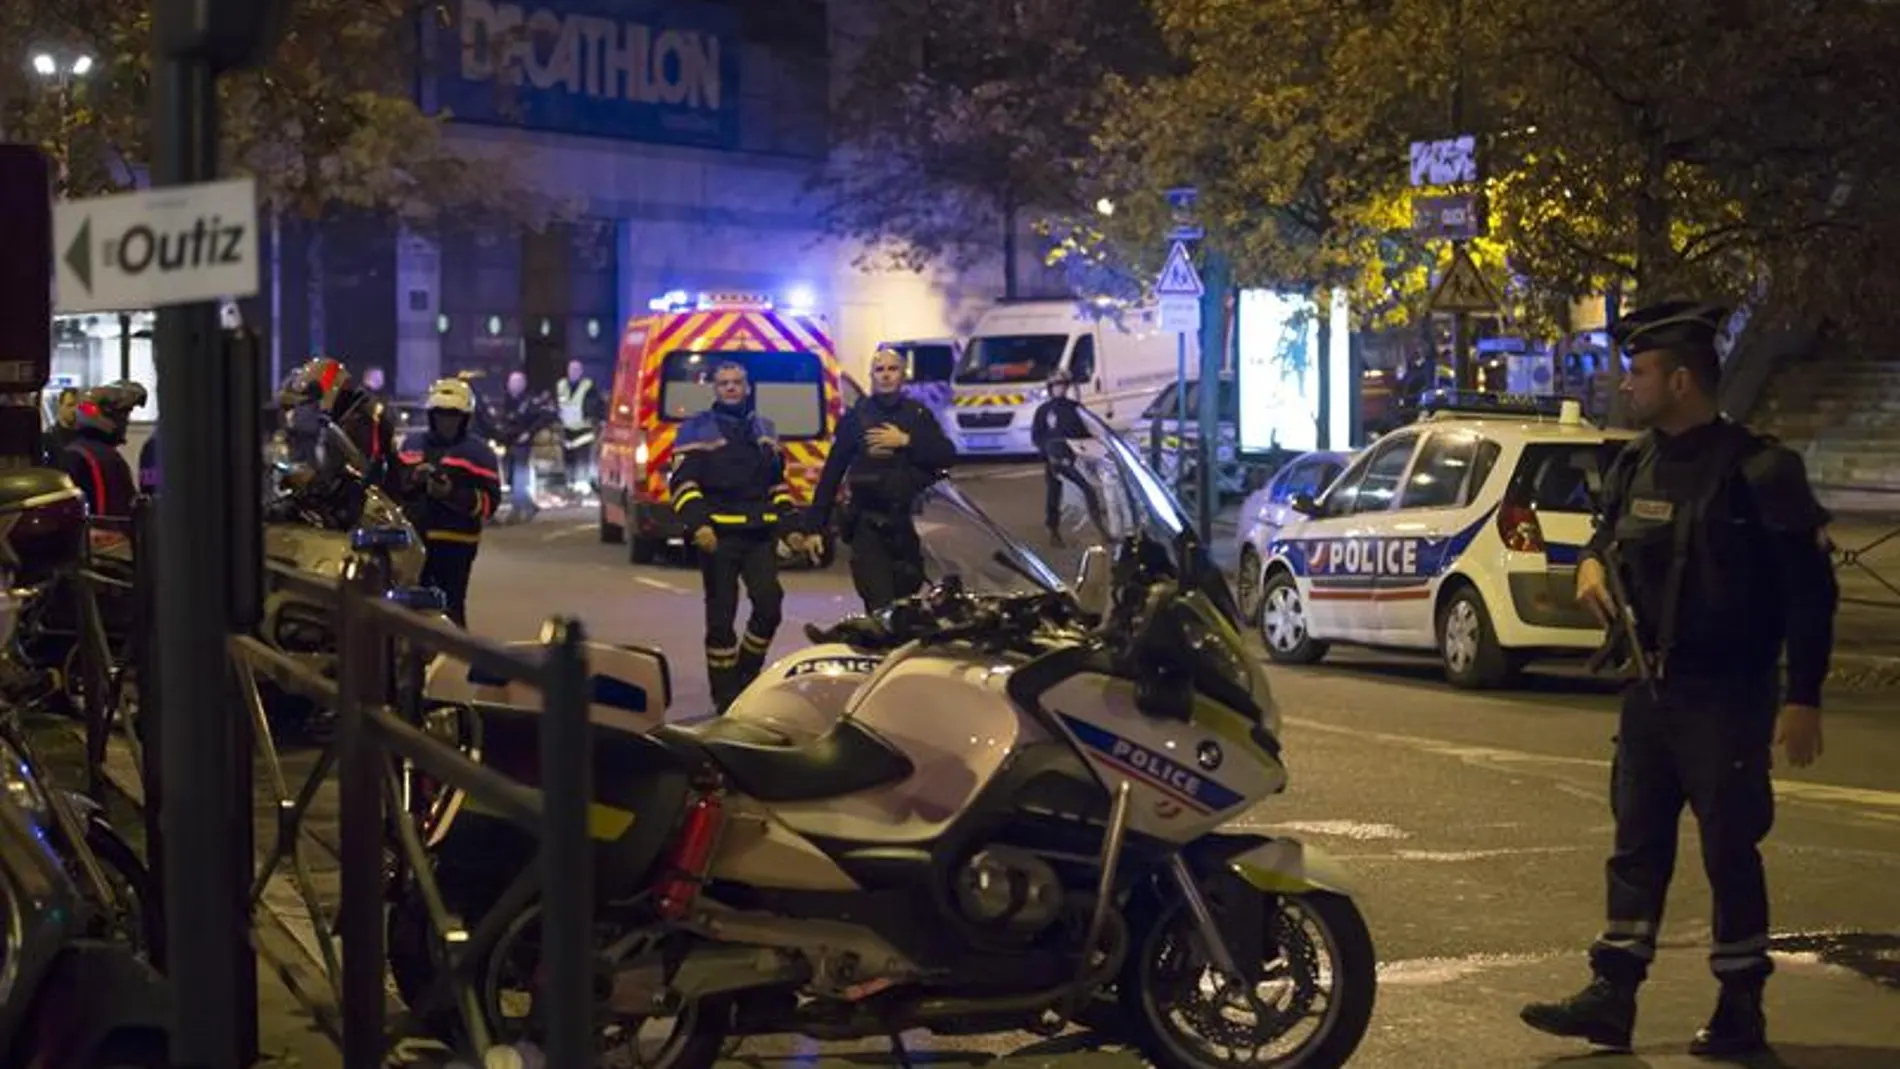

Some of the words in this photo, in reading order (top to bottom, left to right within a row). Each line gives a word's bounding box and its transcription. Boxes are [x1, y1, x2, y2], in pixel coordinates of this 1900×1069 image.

[460, 0, 720, 110] DECATHLON
[117, 214, 245, 276] Outiz
[1329, 540, 1417, 573] POLICE
[1112, 738, 1201, 795] POLICE
